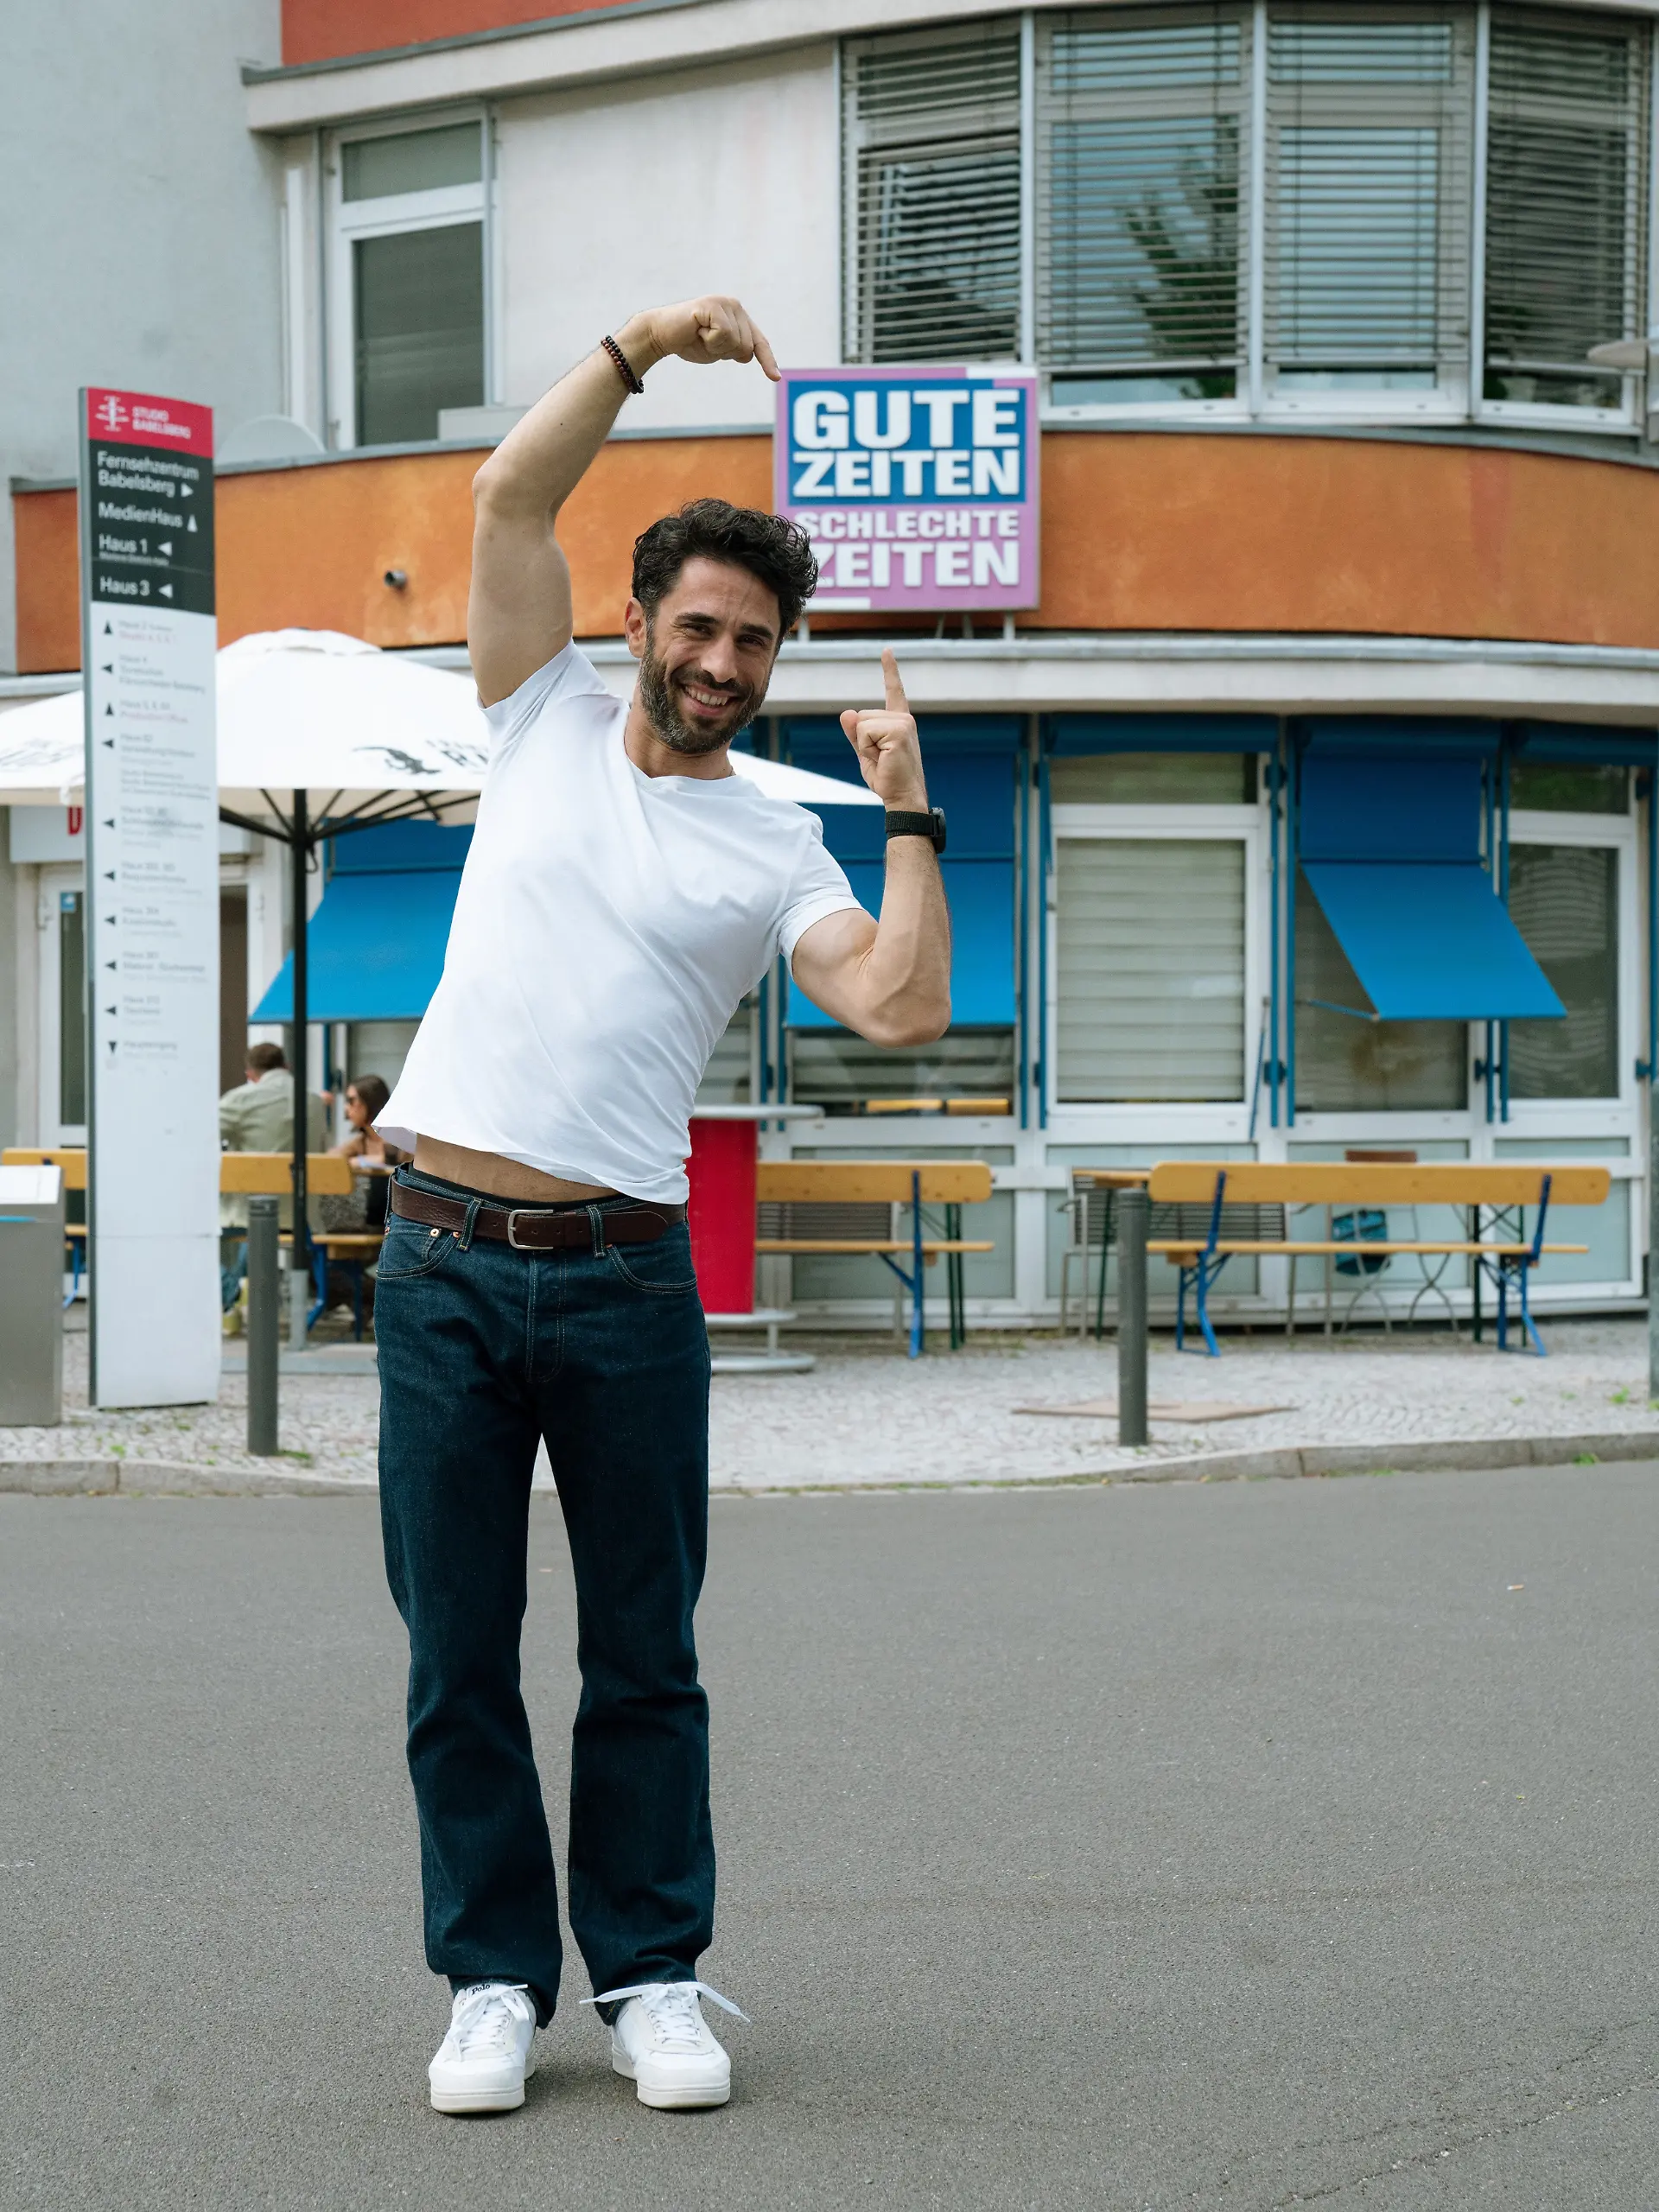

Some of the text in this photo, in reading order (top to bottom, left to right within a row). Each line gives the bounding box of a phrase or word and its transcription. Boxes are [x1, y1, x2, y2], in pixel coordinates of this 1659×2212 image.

[792, 389, 1020, 450] GUTE
[97, 450, 200, 482] Fernsehzentrum
[792, 448, 1020, 498] ZEITEN
[98, 468, 175, 499] Babelsberg
[98, 501, 183, 529] MedienHaus
[793, 509, 1020, 539] SCHLECHTE
[99, 533, 148, 555] Haus 1
[99, 575, 150, 597] Haus 3
[471, 1984, 491, 1996] Polo
